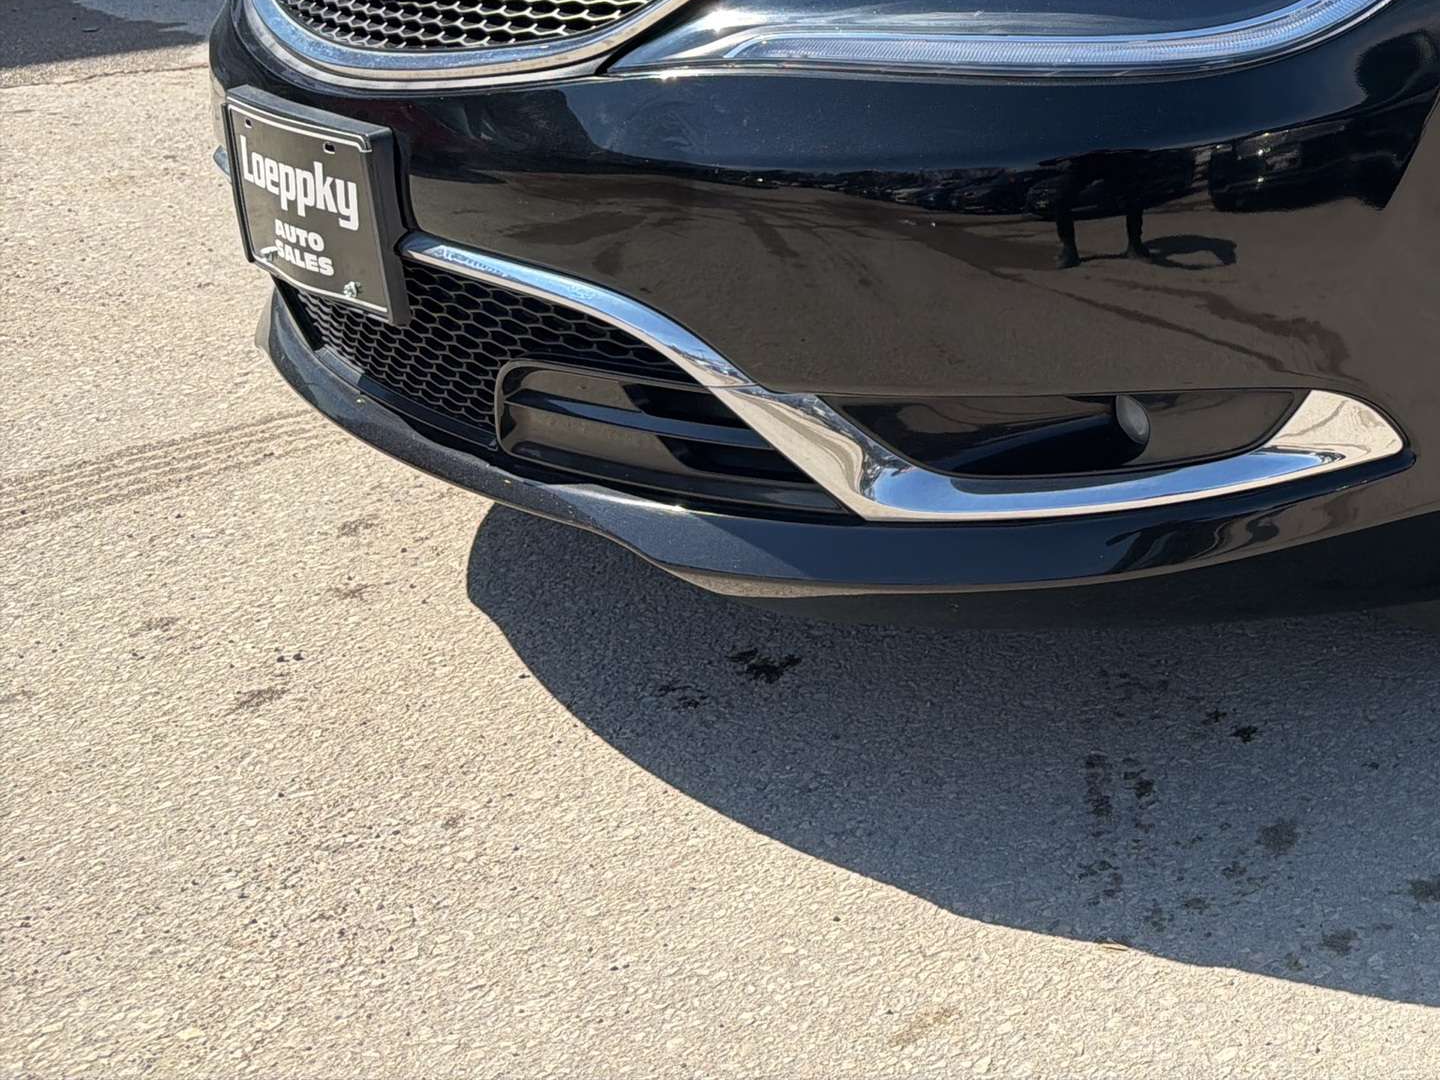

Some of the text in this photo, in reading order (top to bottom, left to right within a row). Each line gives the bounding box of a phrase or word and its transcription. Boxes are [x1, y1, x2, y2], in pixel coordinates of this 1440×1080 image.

[239, 134, 360, 231] Loeppky
[274, 218, 325, 252] AUTO
[274, 240, 335, 277] SALES
